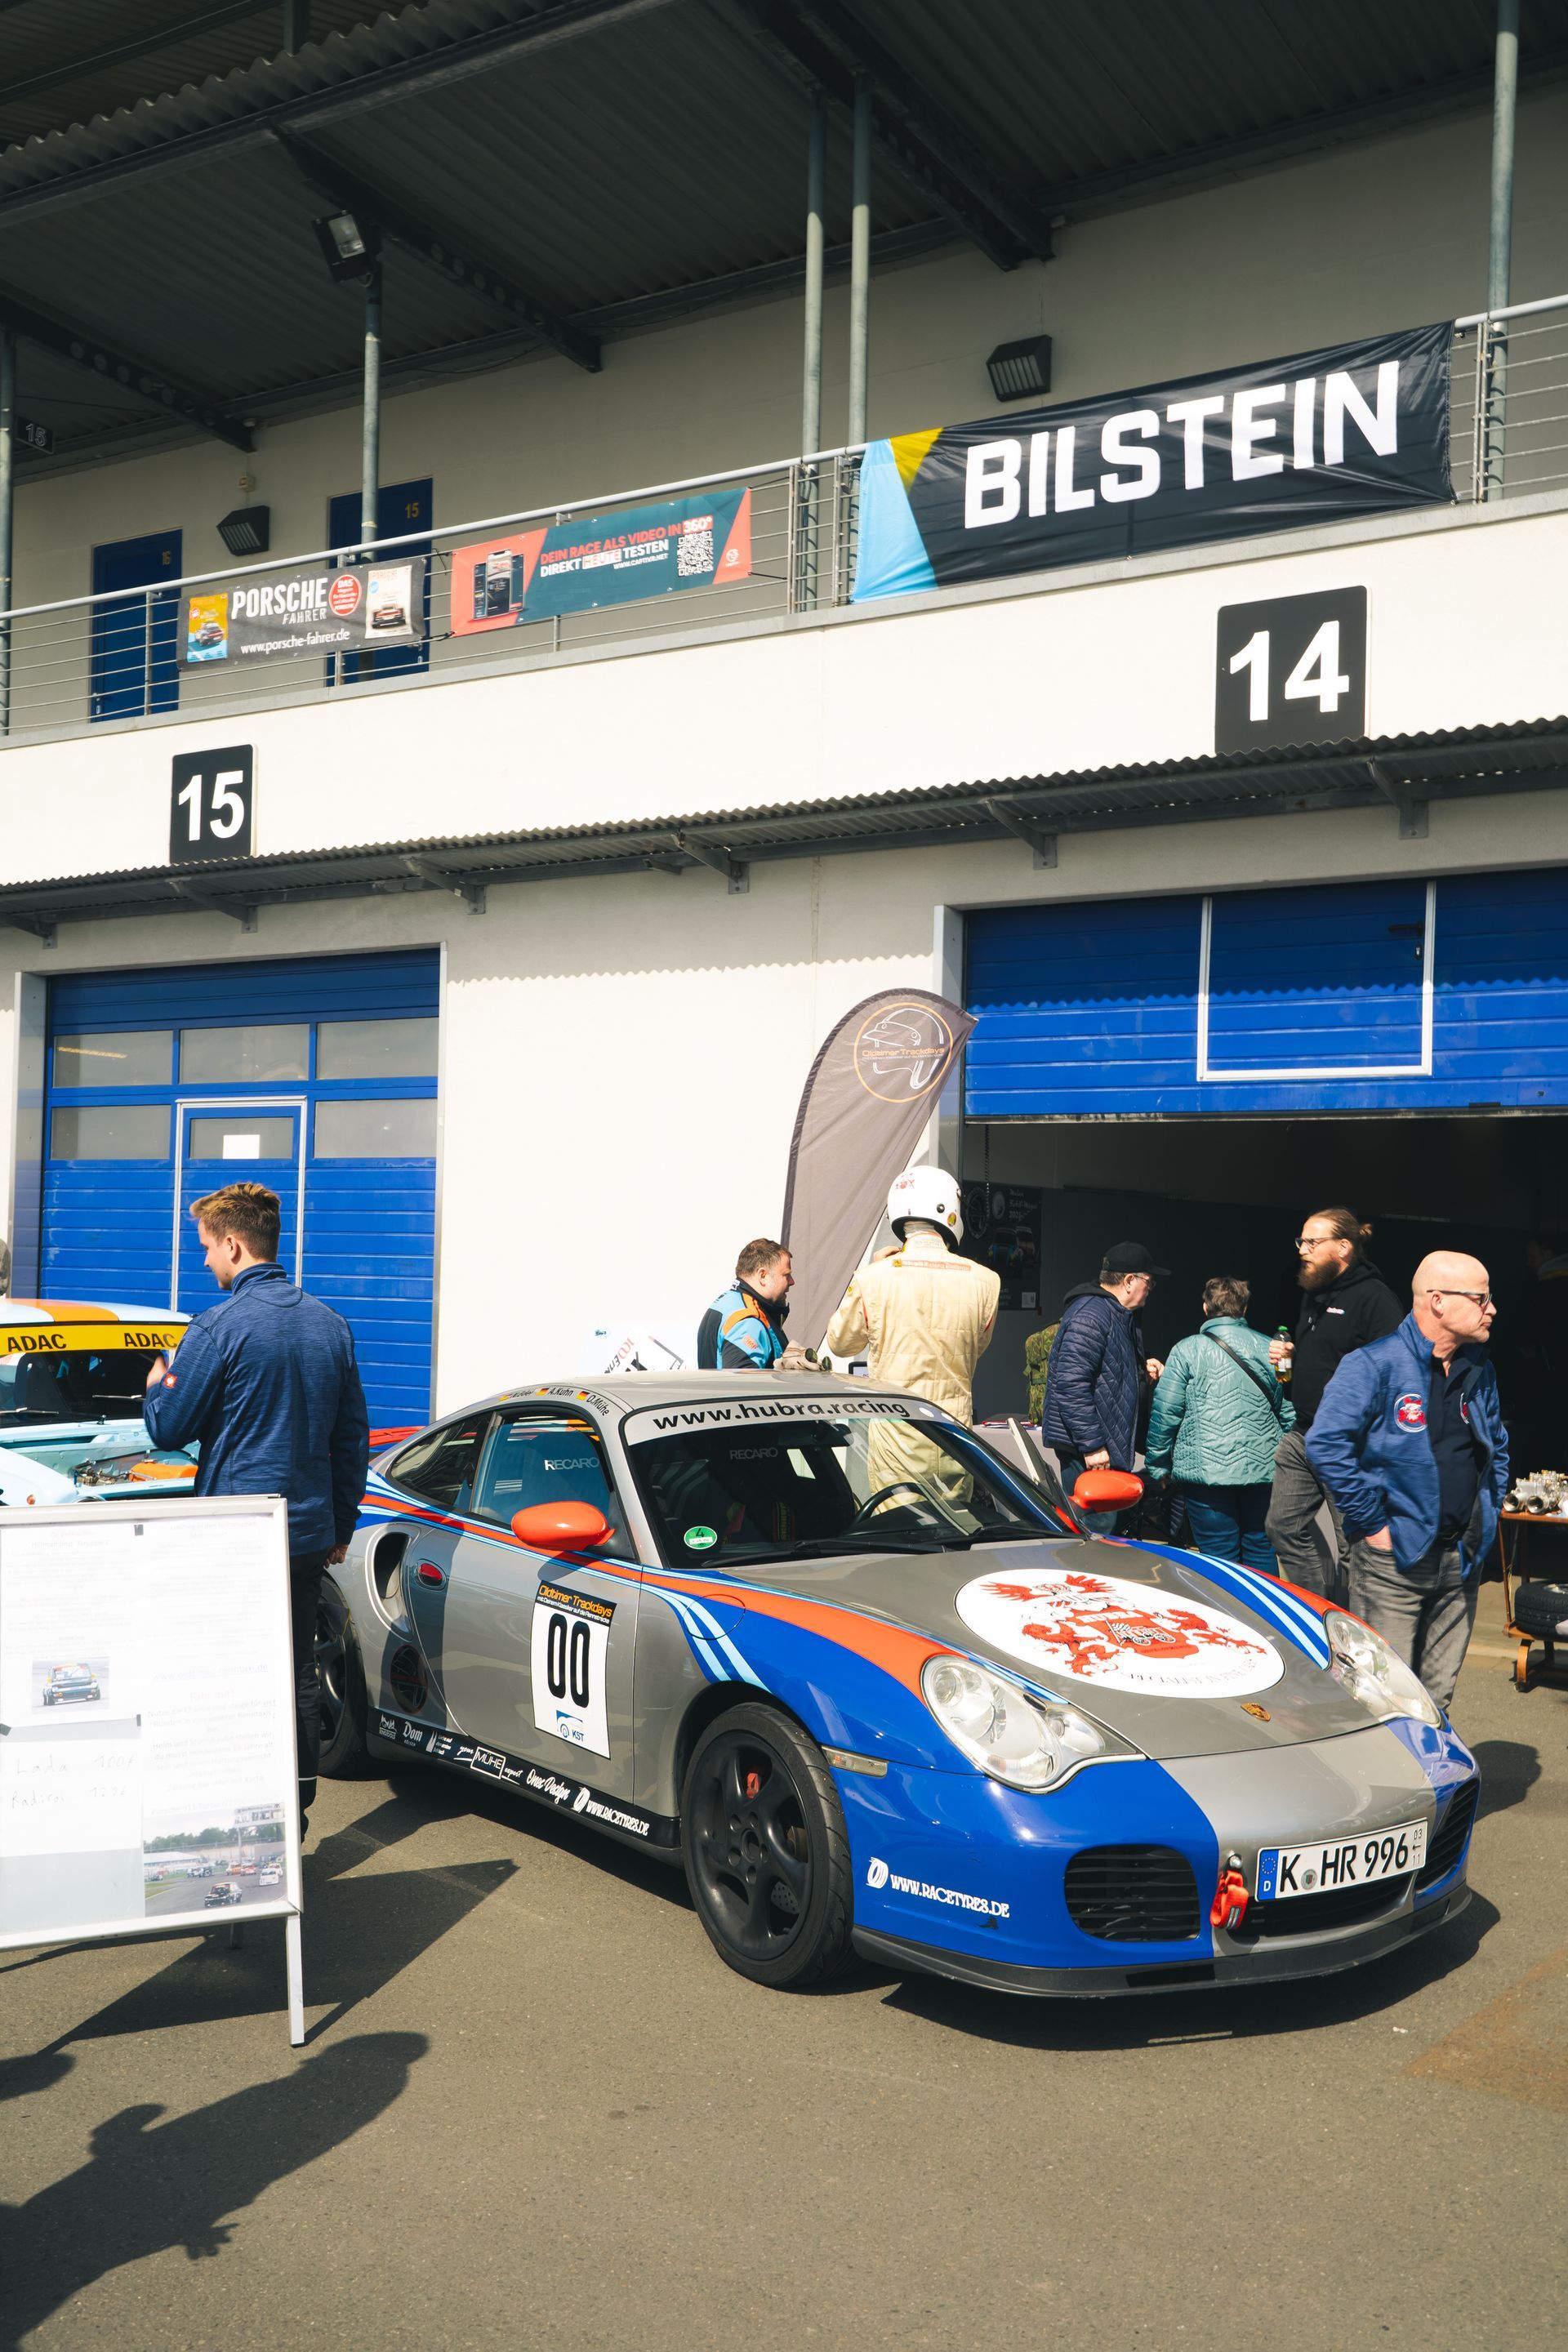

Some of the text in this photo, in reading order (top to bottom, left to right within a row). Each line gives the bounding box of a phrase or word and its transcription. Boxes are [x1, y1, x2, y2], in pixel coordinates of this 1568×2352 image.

[25, 423, 46, 447] 15
[964, 361, 1399, 529] BILSTEIN
[405, 502, 419, 519] 15
[541, 516, 712, 564] DEIN RACE ALS VIDEO IN 360°
[541, 539, 669, 577] DIREKT HEUTE TESTEN
[231, 577, 328, 620] PORSCHE
[282, 608, 327, 625] FAHRER
[241, 628, 350, 654] www.porsche-fahrer.de
[1229, 621, 1349, 721] 14
[179, 770, 243, 840] 15
[901, 1047, 945, 1056] Trackdays
[7, 1334, 67, 1352] ADAC
[124, 1332, 177, 1348] ADAC
[548, 1388, 573, 1397] A.Kuhn
[586, 1394, 609, 1416] D.Mühe
[653, 1399, 911, 1431] www.hubra.racing
[544, 1457, 600, 1470] RECARO
[730, 1446, 778, 1460] RECARO
[696, 1528, 705, 1537] 4
[539, 1585, 612, 1618] Oldtimer Trackdays
[547, 1613, 590, 1708] 00
[403, 1721, 423, 1742] Dom
[572, 1729, 584, 1742] KST
[457, 1745, 474, 1756] your
[474, 1751, 503, 1769] MÜHE
[586, 1800, 650, 1836] WWW.RACETYRES.DE
[1414, 1829, 1423, 1839] 03
[1263, 1833, 1408, 1892] D K HR 996
[1412, 1854, 1421, 1865] 11
[890, 1874, 1010, 1918] WWW.RACETYRES.DE
